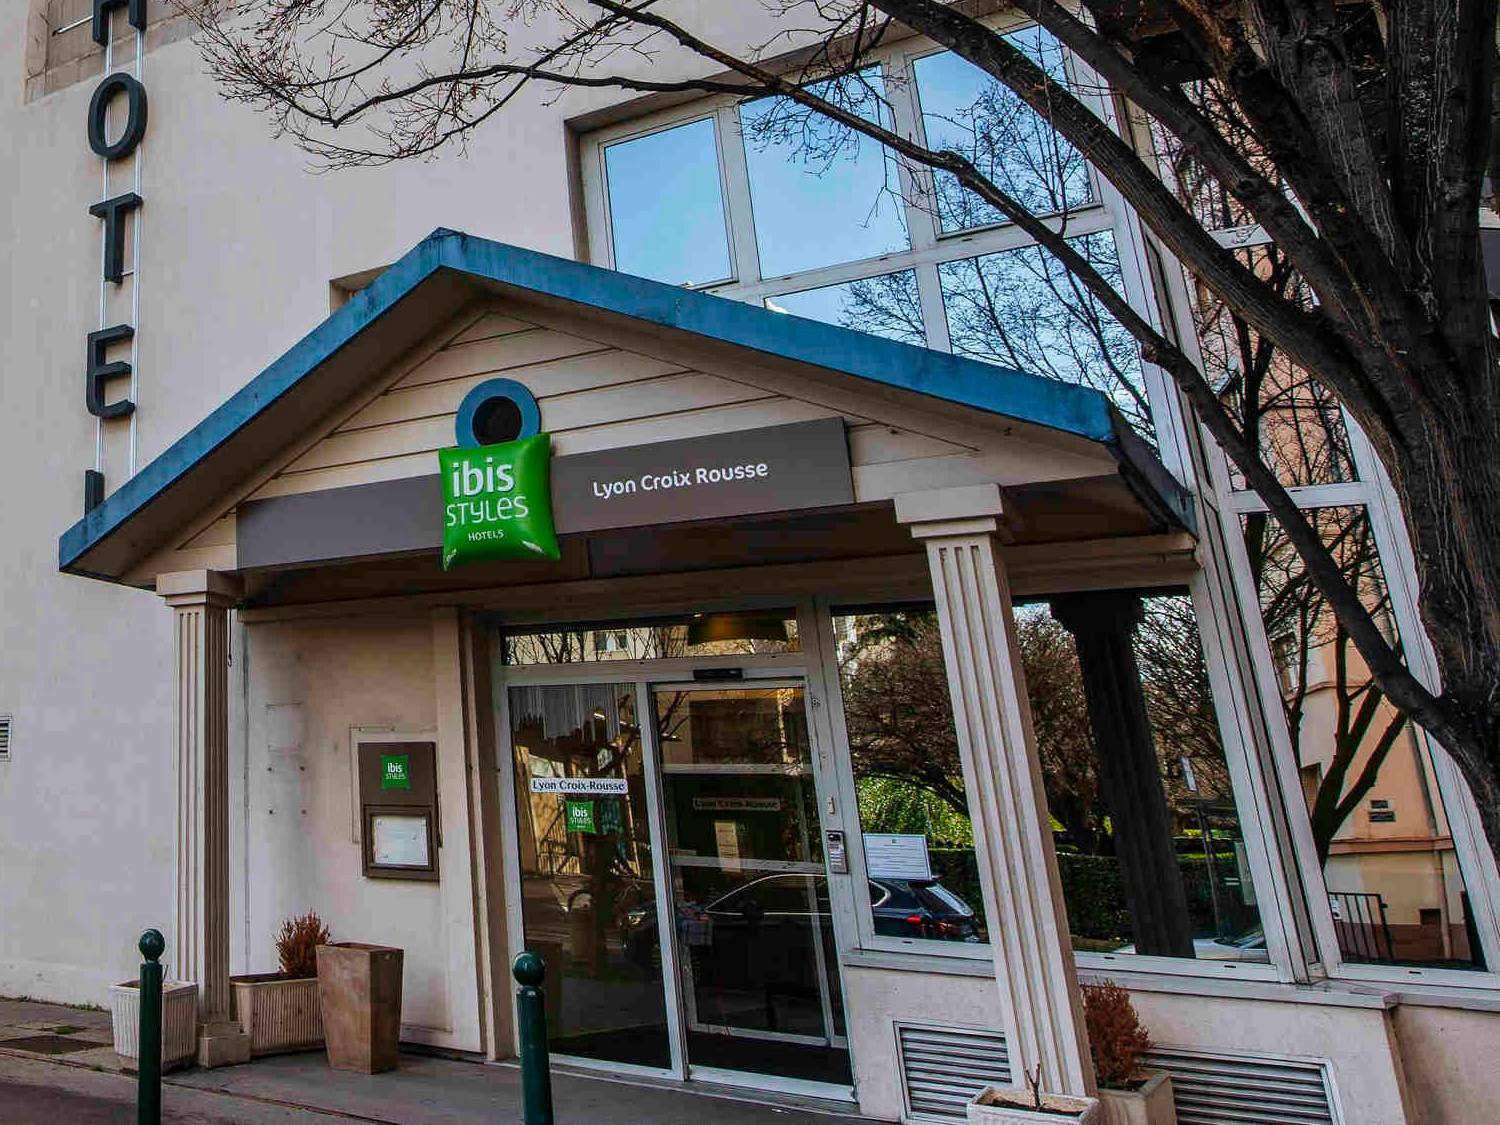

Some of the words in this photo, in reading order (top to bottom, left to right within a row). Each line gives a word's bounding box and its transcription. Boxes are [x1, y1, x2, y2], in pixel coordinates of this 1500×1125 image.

[452, 456, 515, 497] ibis
[593, 479, 637, 499] Lyon
[641, 470, 692, 491] Croix
[695, 462, 769, 485] Rousse
[467, 529, 504, 542] HOTELS
[387, 762, 403, 773] ibis
[533, 780, 557, 791] Lyon
[559, 779, 626, 791] Croix-Rousse
[572, 805, 589, 817] ibis
